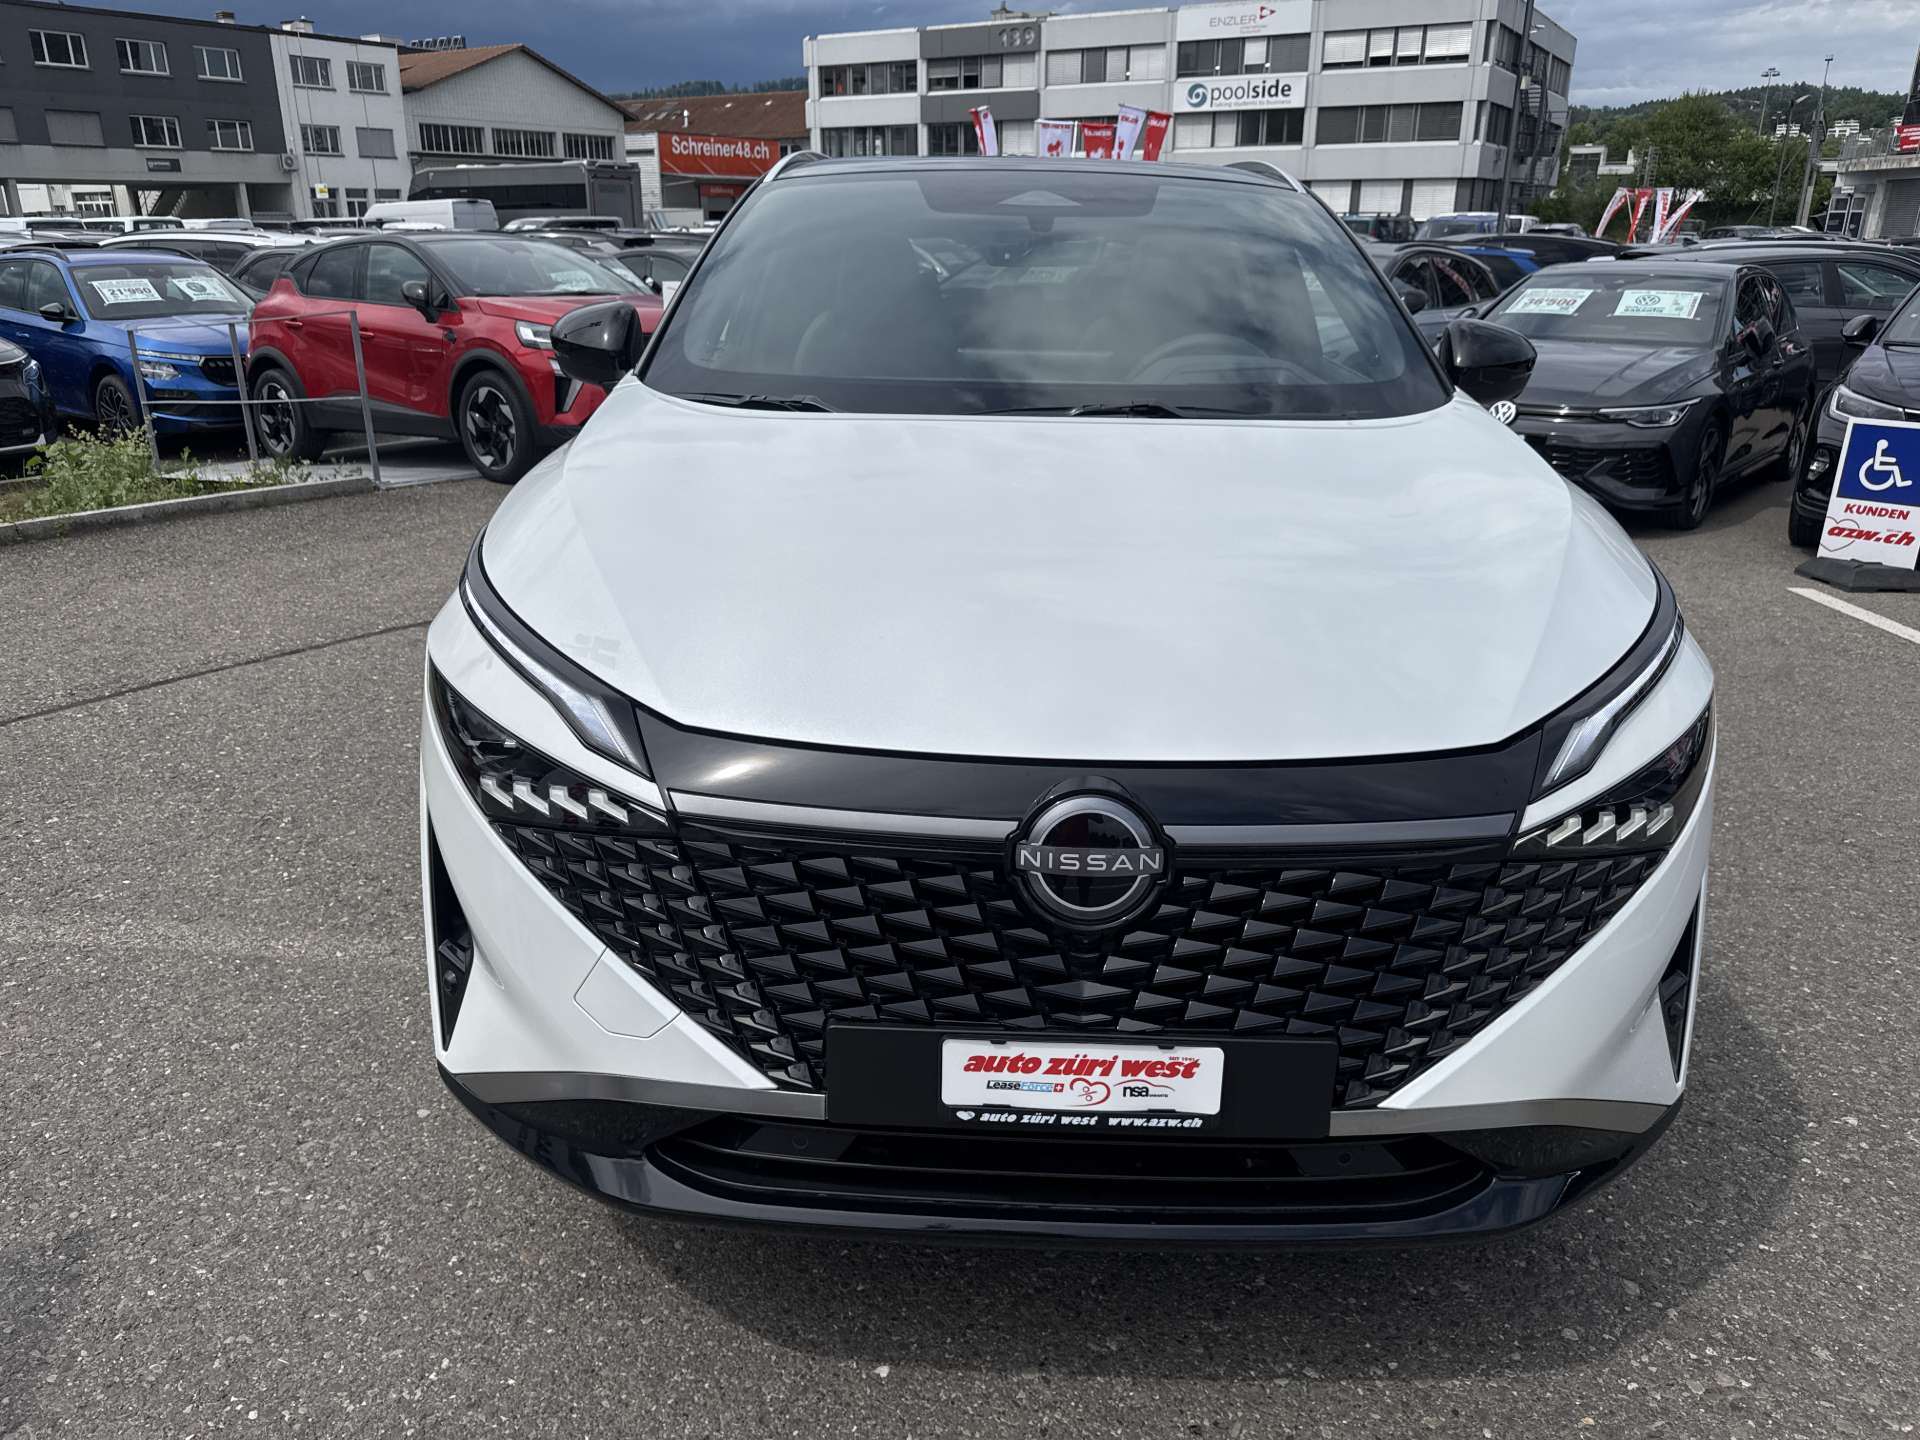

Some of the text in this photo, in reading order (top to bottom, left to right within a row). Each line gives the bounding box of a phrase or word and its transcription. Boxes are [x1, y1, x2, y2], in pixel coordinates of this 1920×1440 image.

[1209, 15, 1257, 27] ENZLER
[1210, 78, 1292, 108] poolside
[671, 136, 770, 159] Schreiner48.ch
[1844, 503, 1910, 520] KUNDEN
[1827, 526, 1916, 546] azw.ch
[1020, 850, 1160, 871] NISSAN
[963, 1052, 1200, 1079] auto züri west
[1122, 1086, 1150, 1098] nsa
[979, 1111, 1203, 1128] auto züri west www.azw.ch
